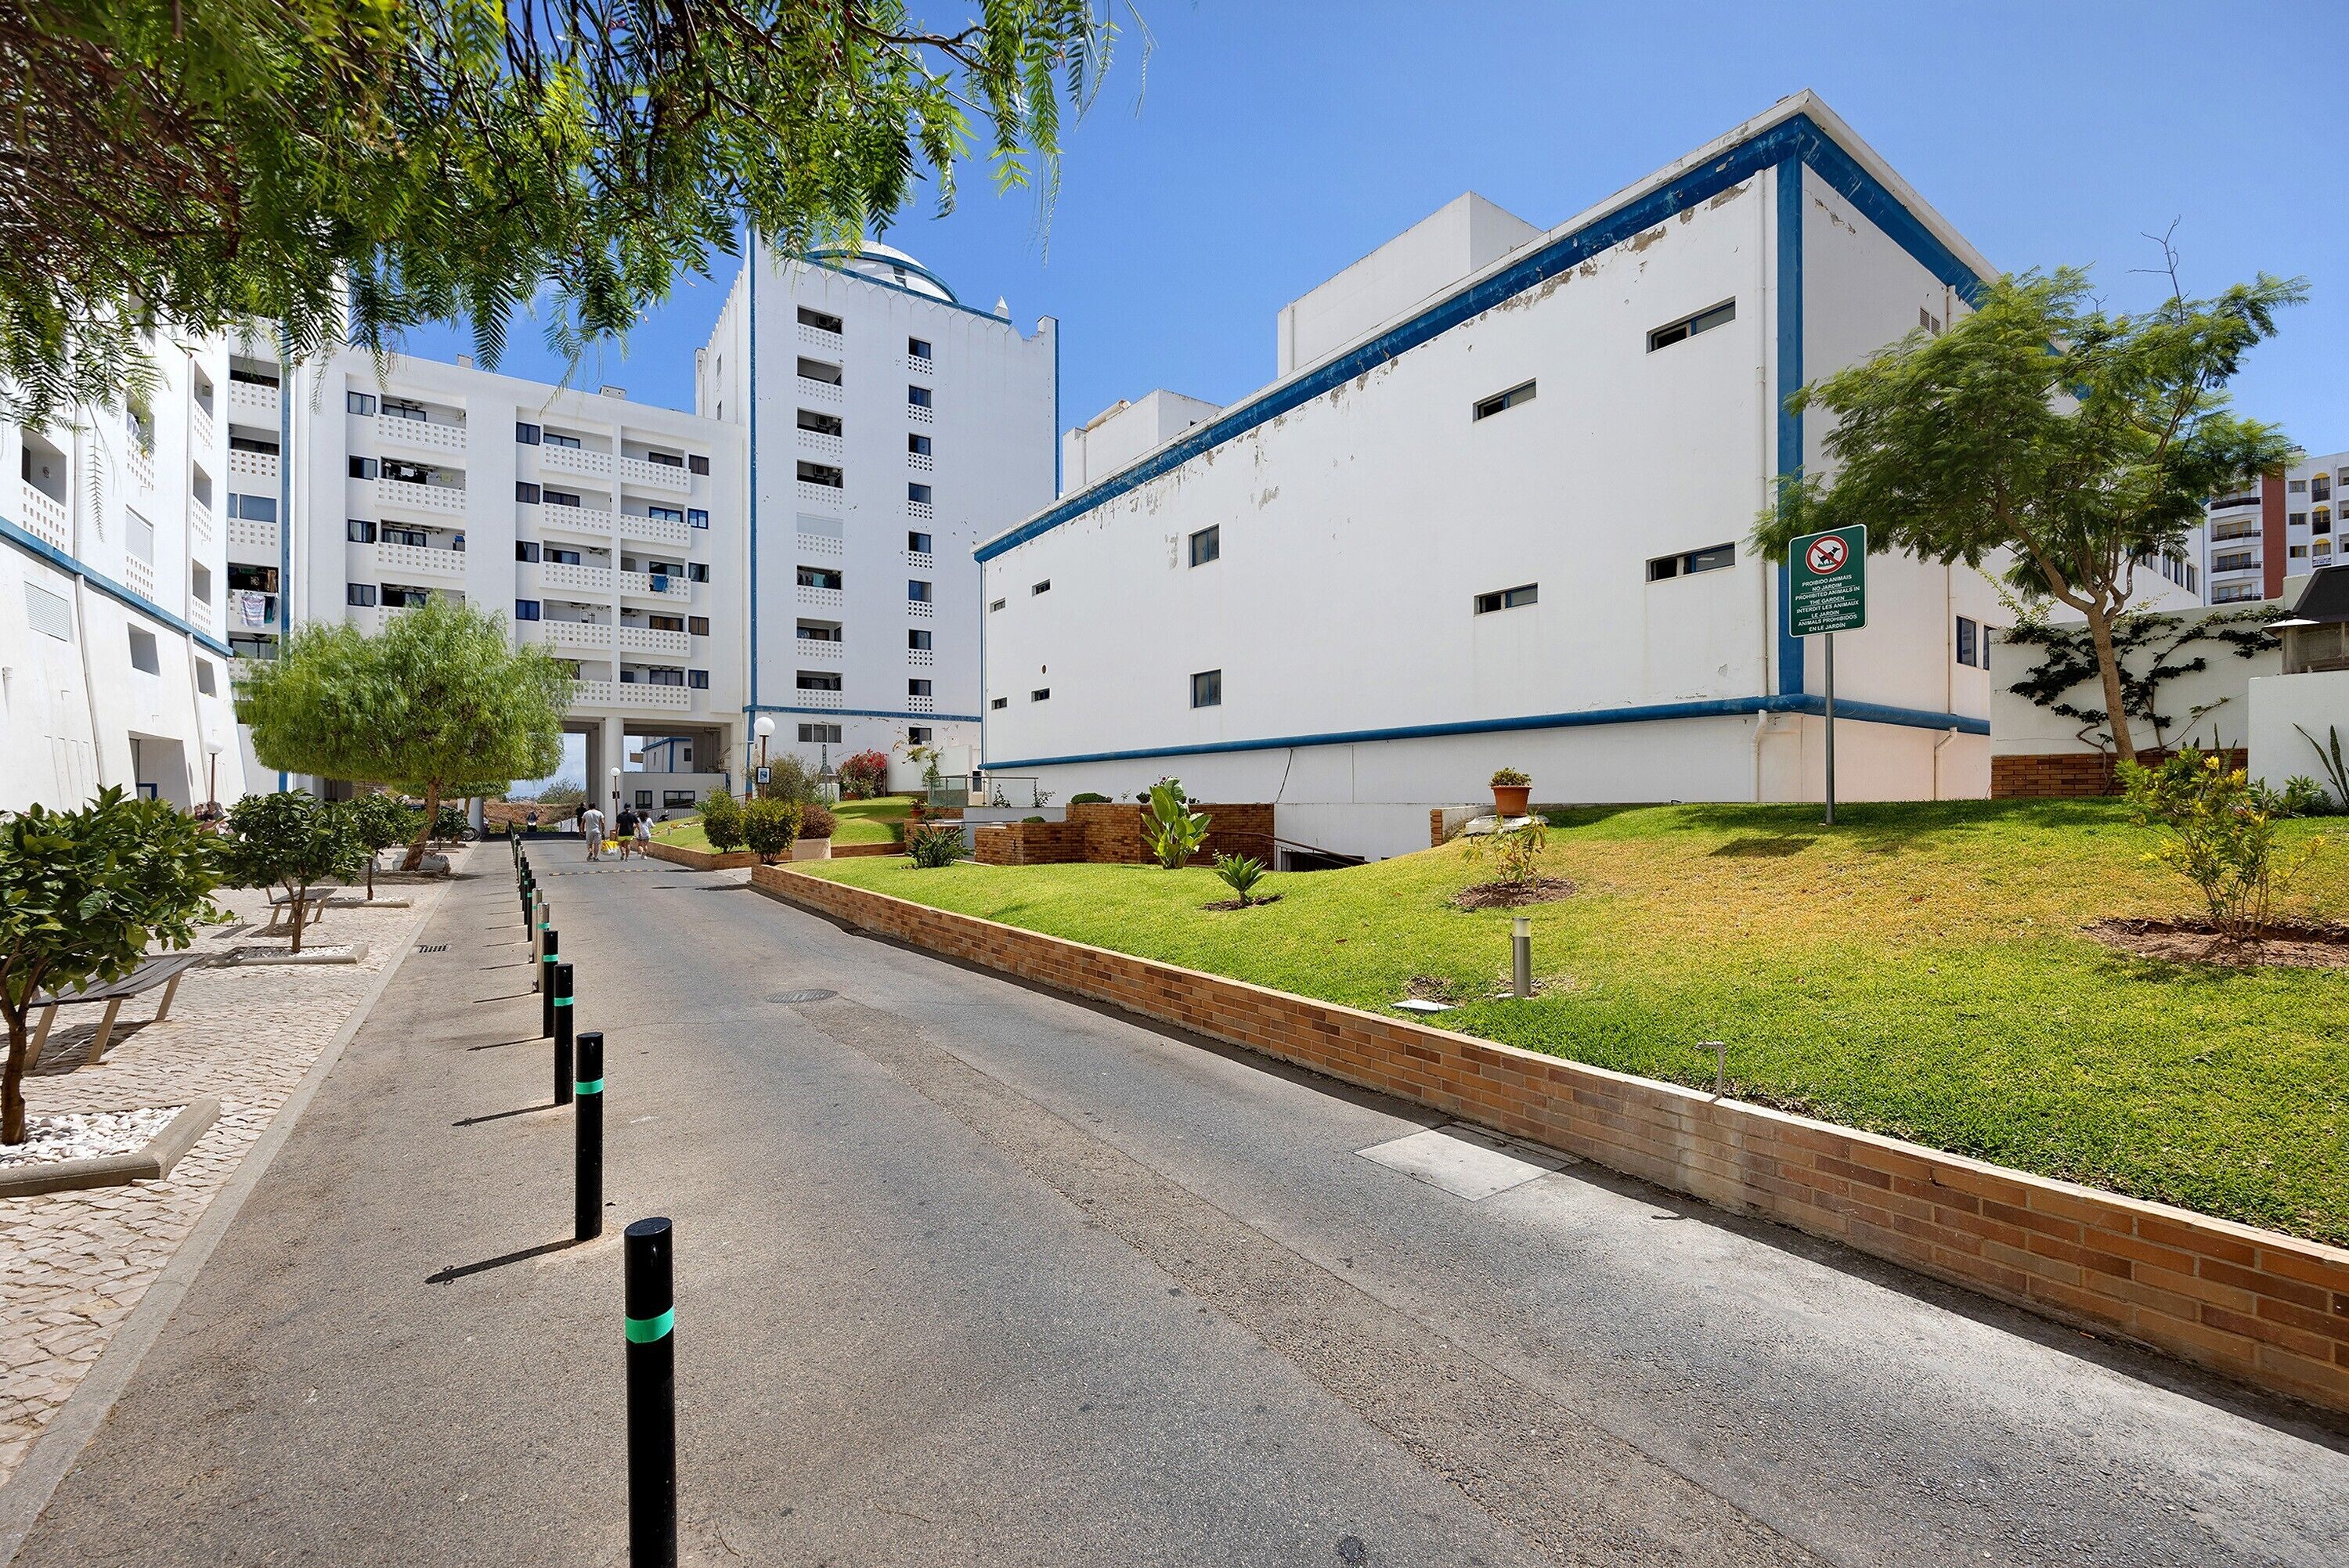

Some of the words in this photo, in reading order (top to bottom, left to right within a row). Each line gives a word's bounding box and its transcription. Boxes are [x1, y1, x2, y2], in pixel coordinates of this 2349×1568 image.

[1802, 579, 1828, 587] PROIBIDO
[1829, 574, 1853, 582] ANIMAIS
[1795, 591, 1828, 600] PROHIBITED
[1828, 586, 1853, 595] ANIMALS
[1796, 605, 1821, 614] INTERDIT
[1833, 600, 1860, 608] ANIMAUX
[1822, 614, 1858, 623] PROHIBIDOS
